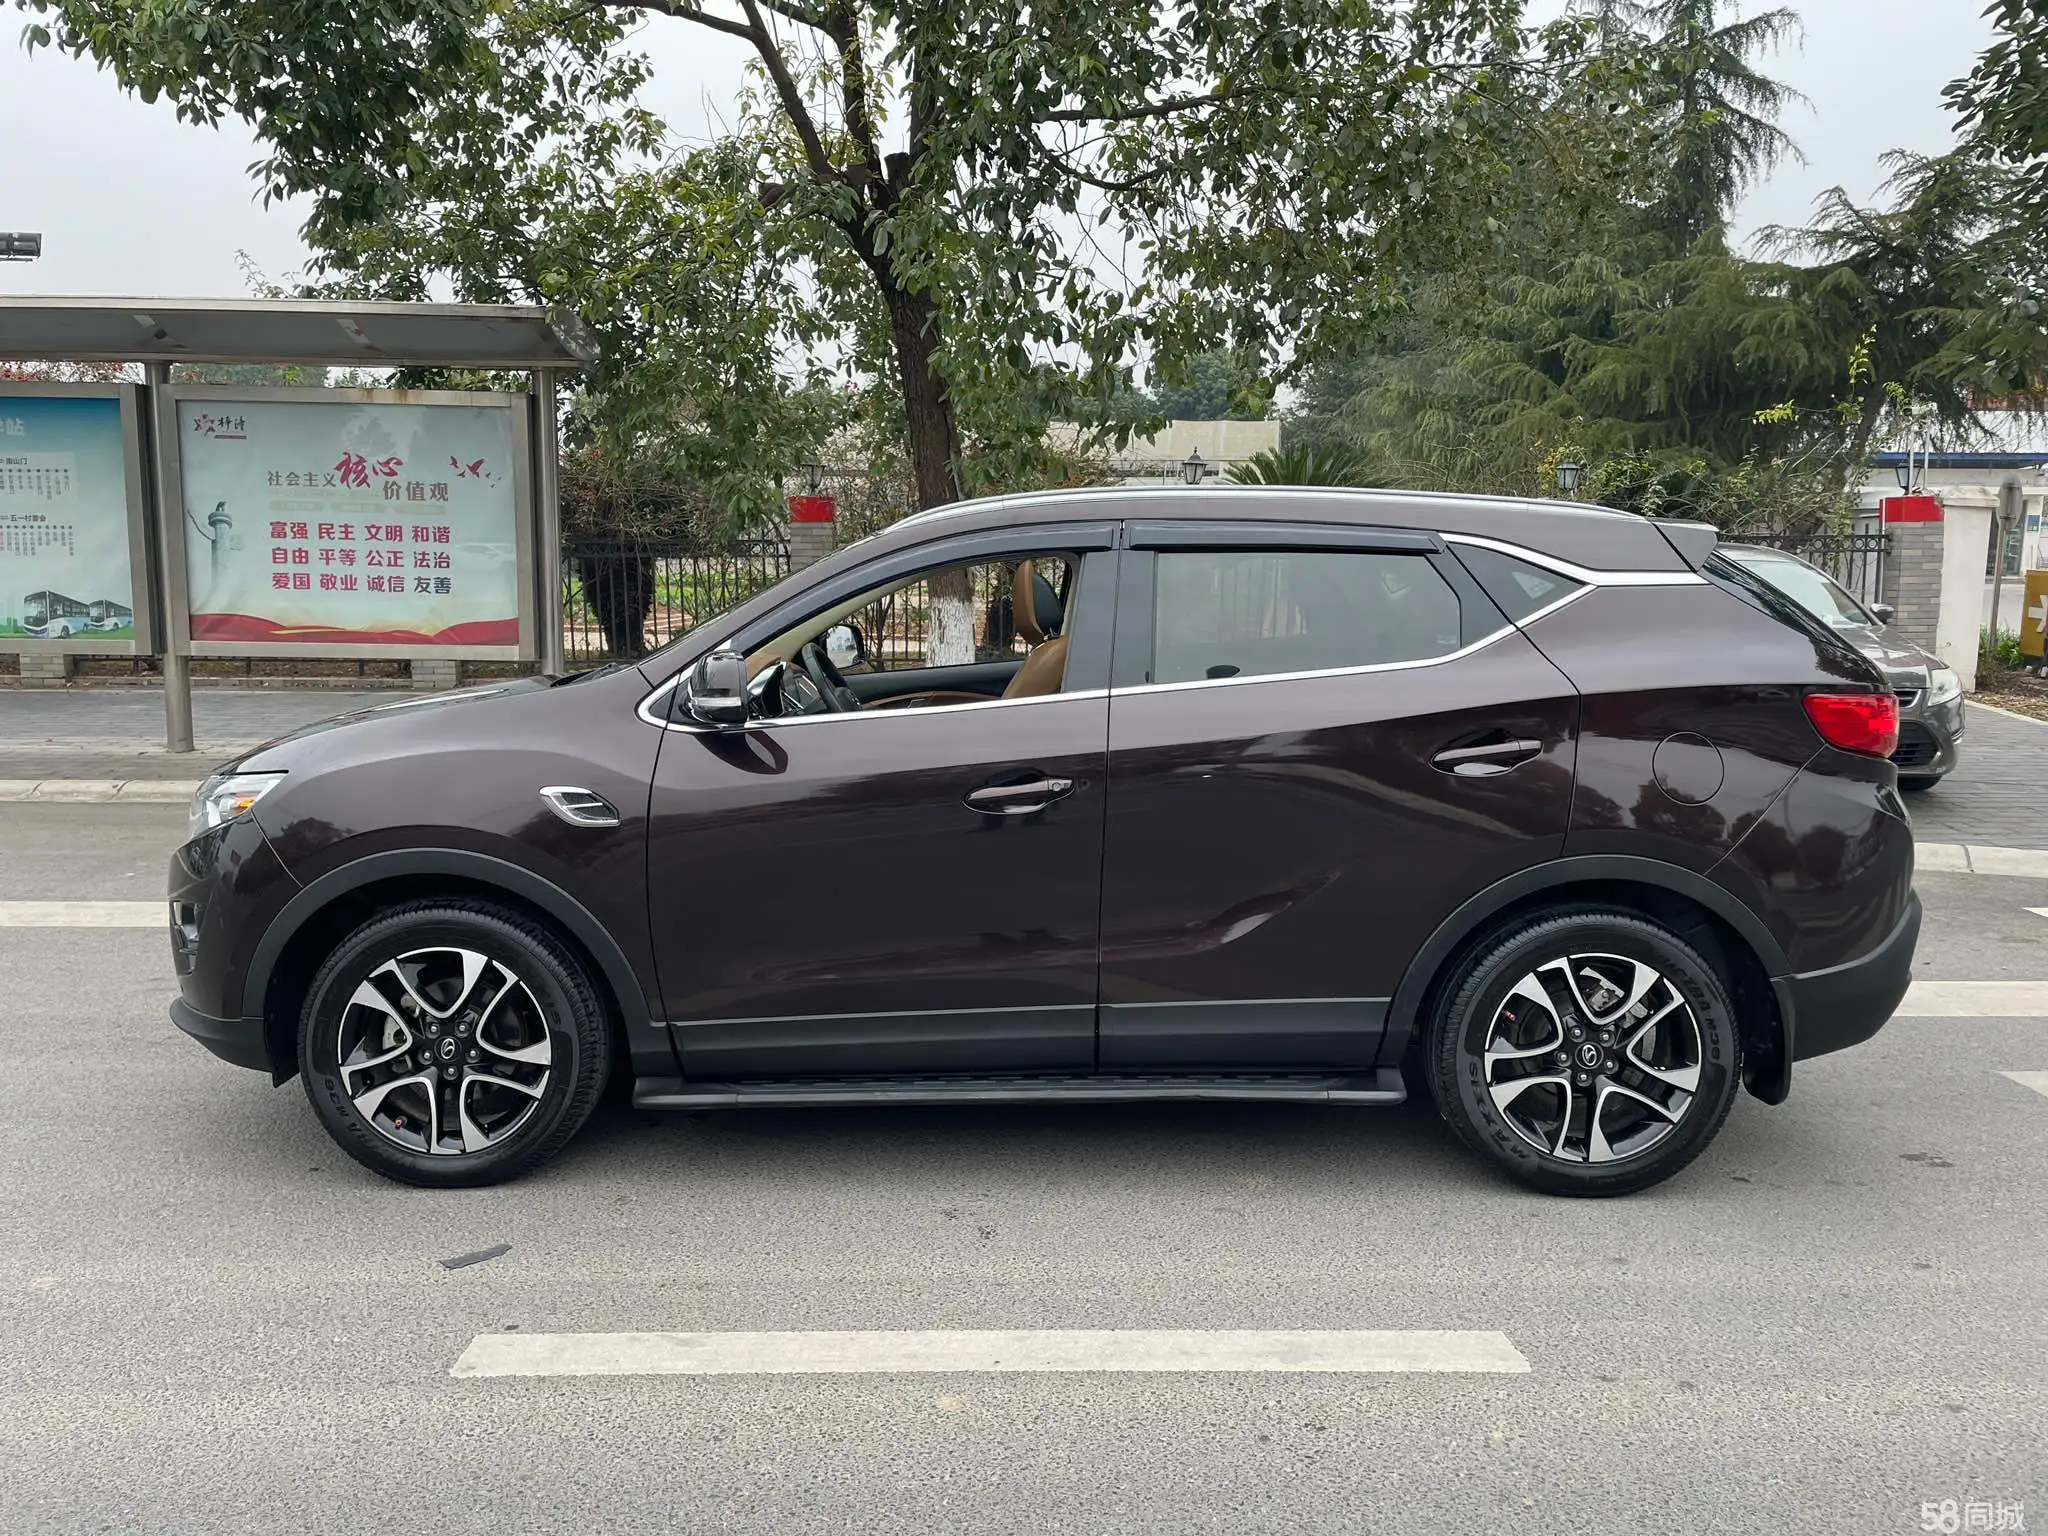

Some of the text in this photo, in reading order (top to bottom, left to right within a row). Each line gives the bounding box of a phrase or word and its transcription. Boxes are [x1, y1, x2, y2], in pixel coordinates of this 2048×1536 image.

[268, 471, 336, 487] 社会主义
[334, 452, 403, 489] 核心
[383, 480, 449, 501] 价值观
[269, 521, 450, 544] 富强 民主 文明 和谐
[272, 547, 450, 569] 自由 平等 公正 法治
[272, 572, 452, 594] 爱国 敬业 诚信 友善
